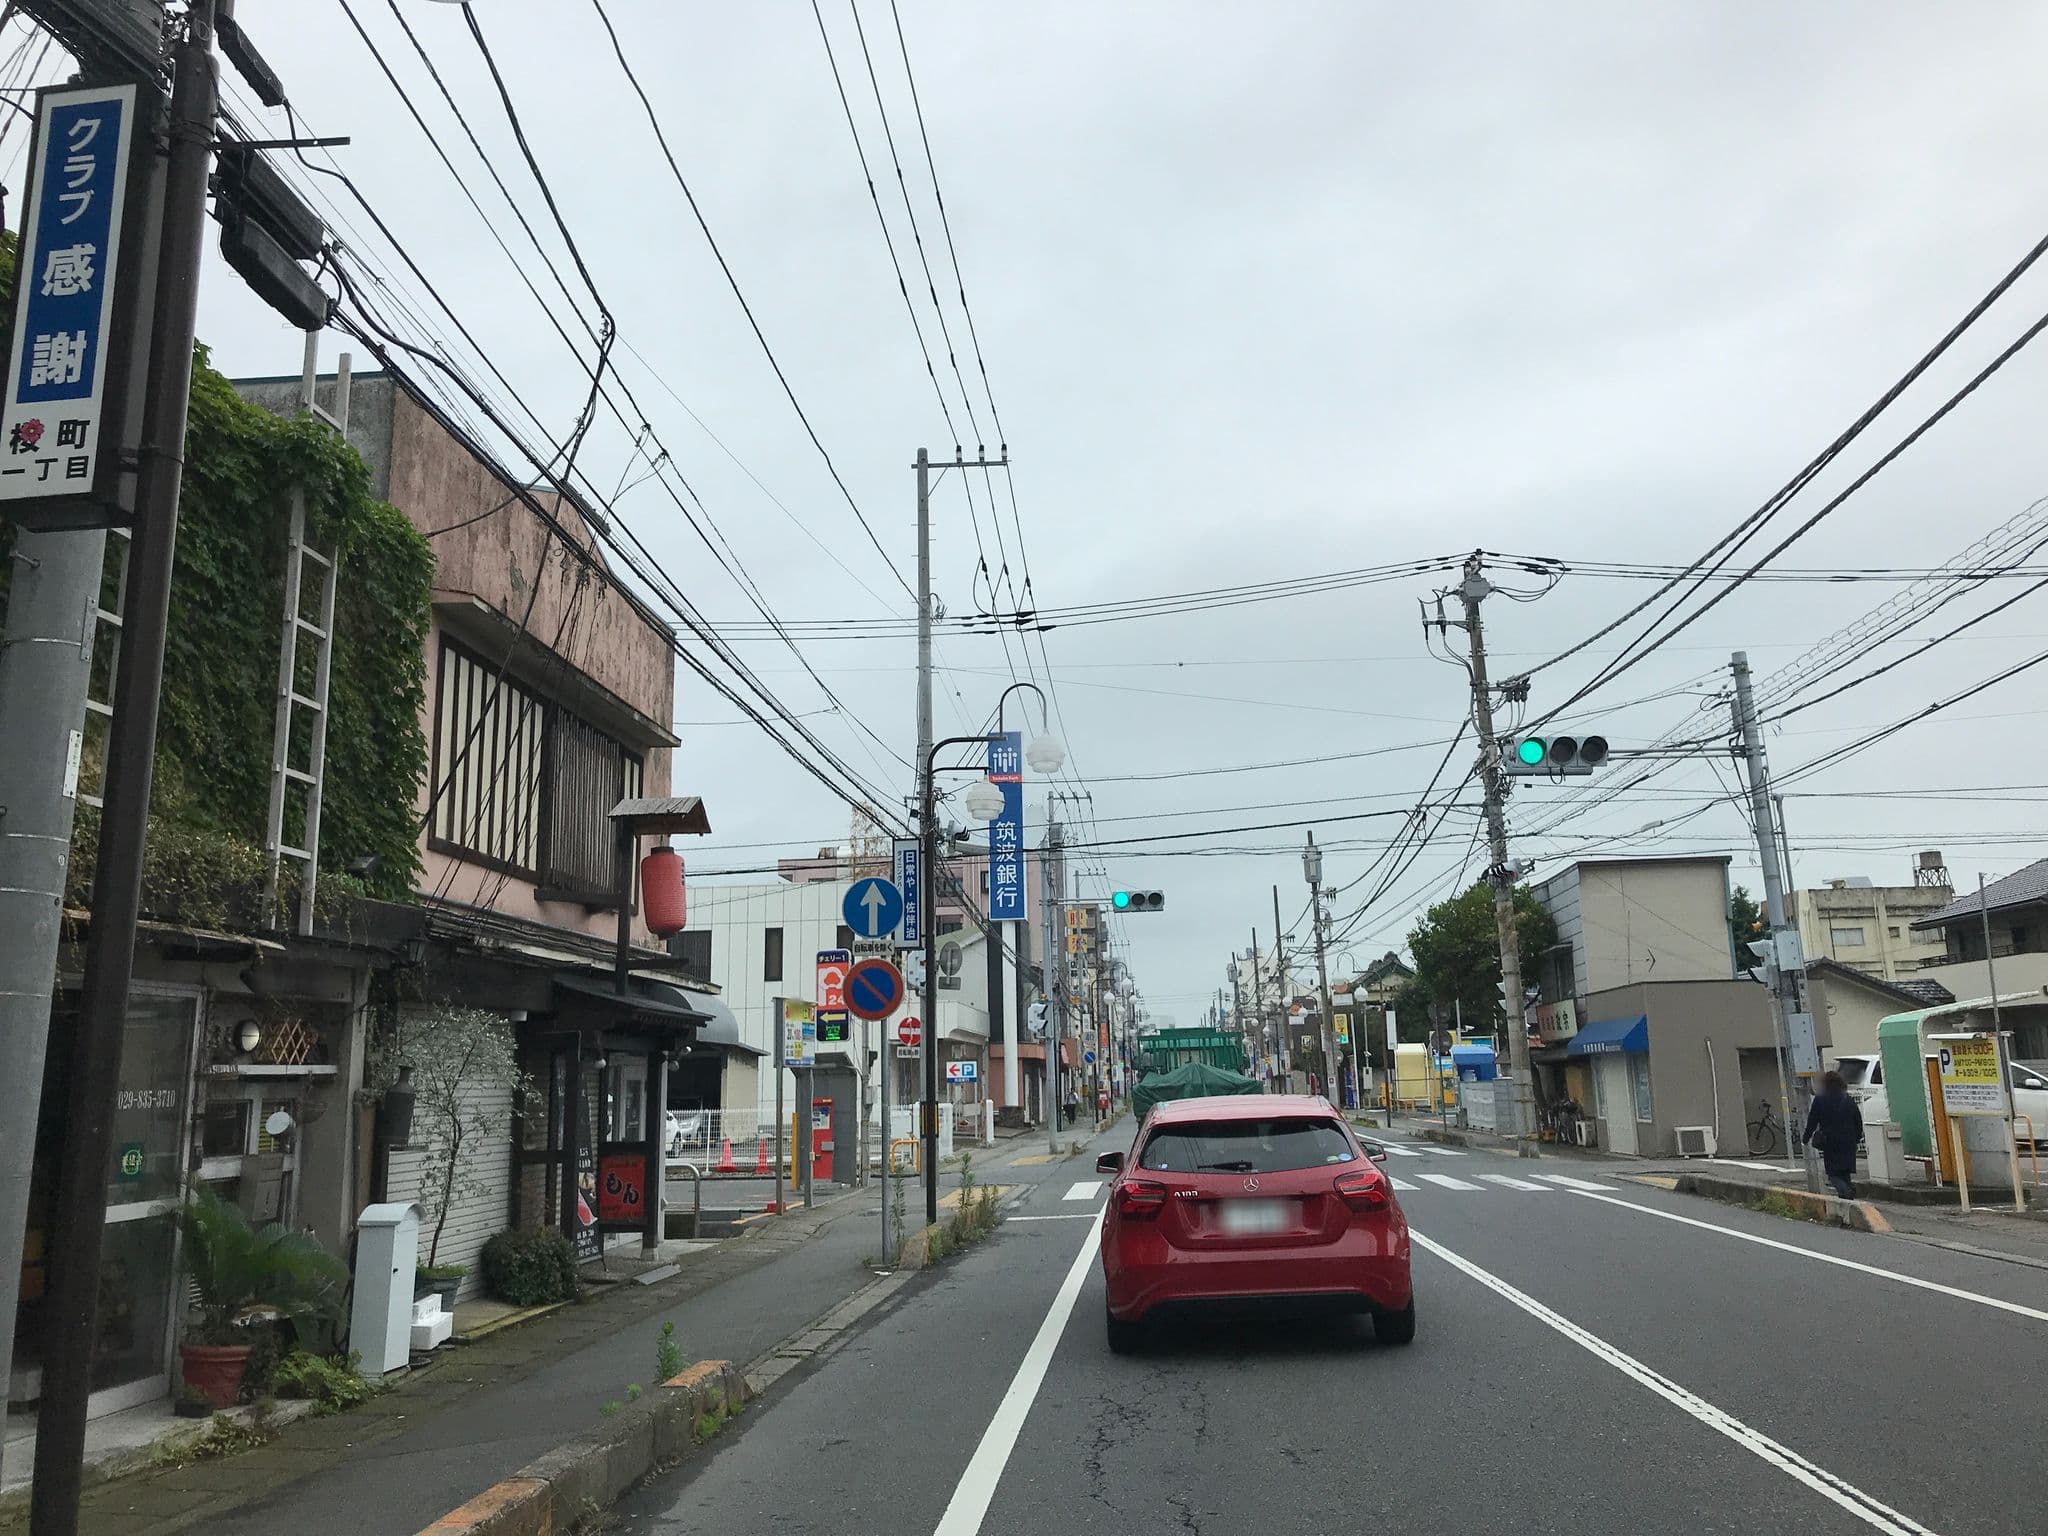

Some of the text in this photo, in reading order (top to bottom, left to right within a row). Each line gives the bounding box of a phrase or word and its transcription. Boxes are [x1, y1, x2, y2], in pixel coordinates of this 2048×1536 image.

[30, 117, 101, 388] クラブ感謝
[1, 455, 89, 480] 一丁目
[995, 821, 1018, 908] 筑波銀行
[854, 943, 893, 953] 自転車を除く
[963, 1064, 973, 1076] P
[1940, 1048, 1951, 1074] P
[118, 1090, 176, 1109] 029-835-3710
